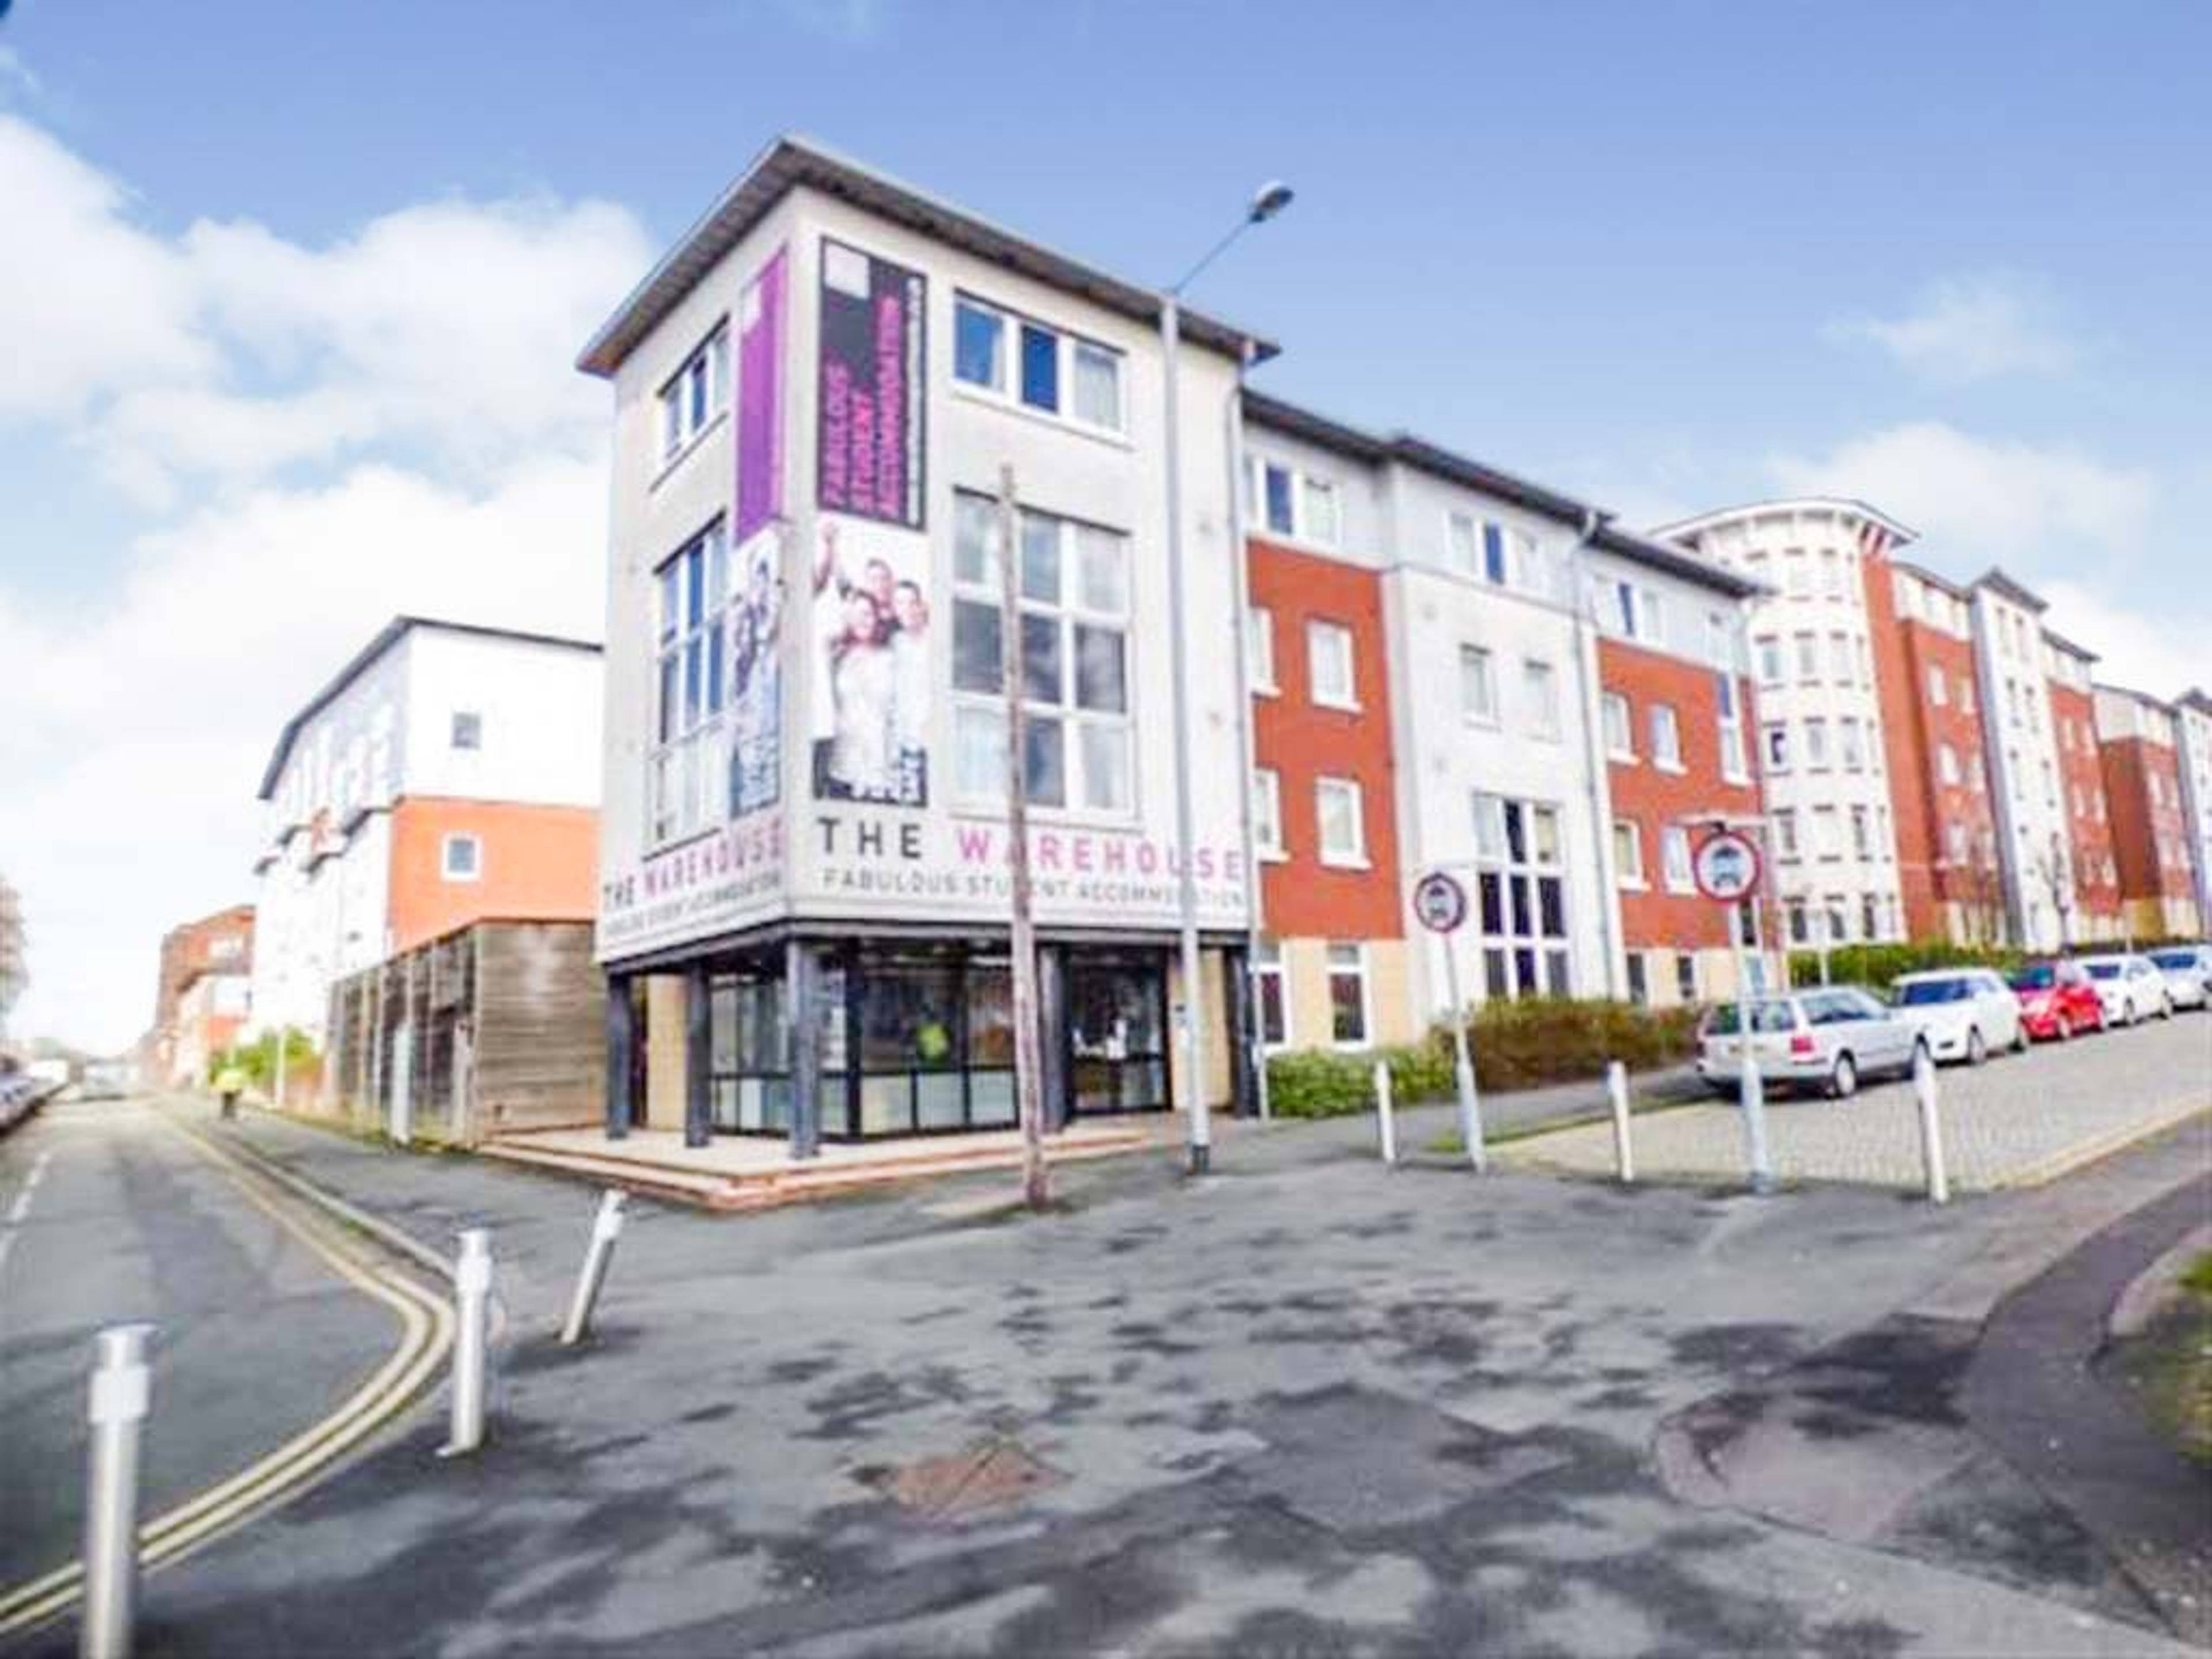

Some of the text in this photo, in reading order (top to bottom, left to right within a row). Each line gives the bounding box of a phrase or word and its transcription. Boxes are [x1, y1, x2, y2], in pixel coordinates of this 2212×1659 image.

[816, 817, 1243, 881] THE WREHOUSE
[967, 874, 1069, 899] STUNT
